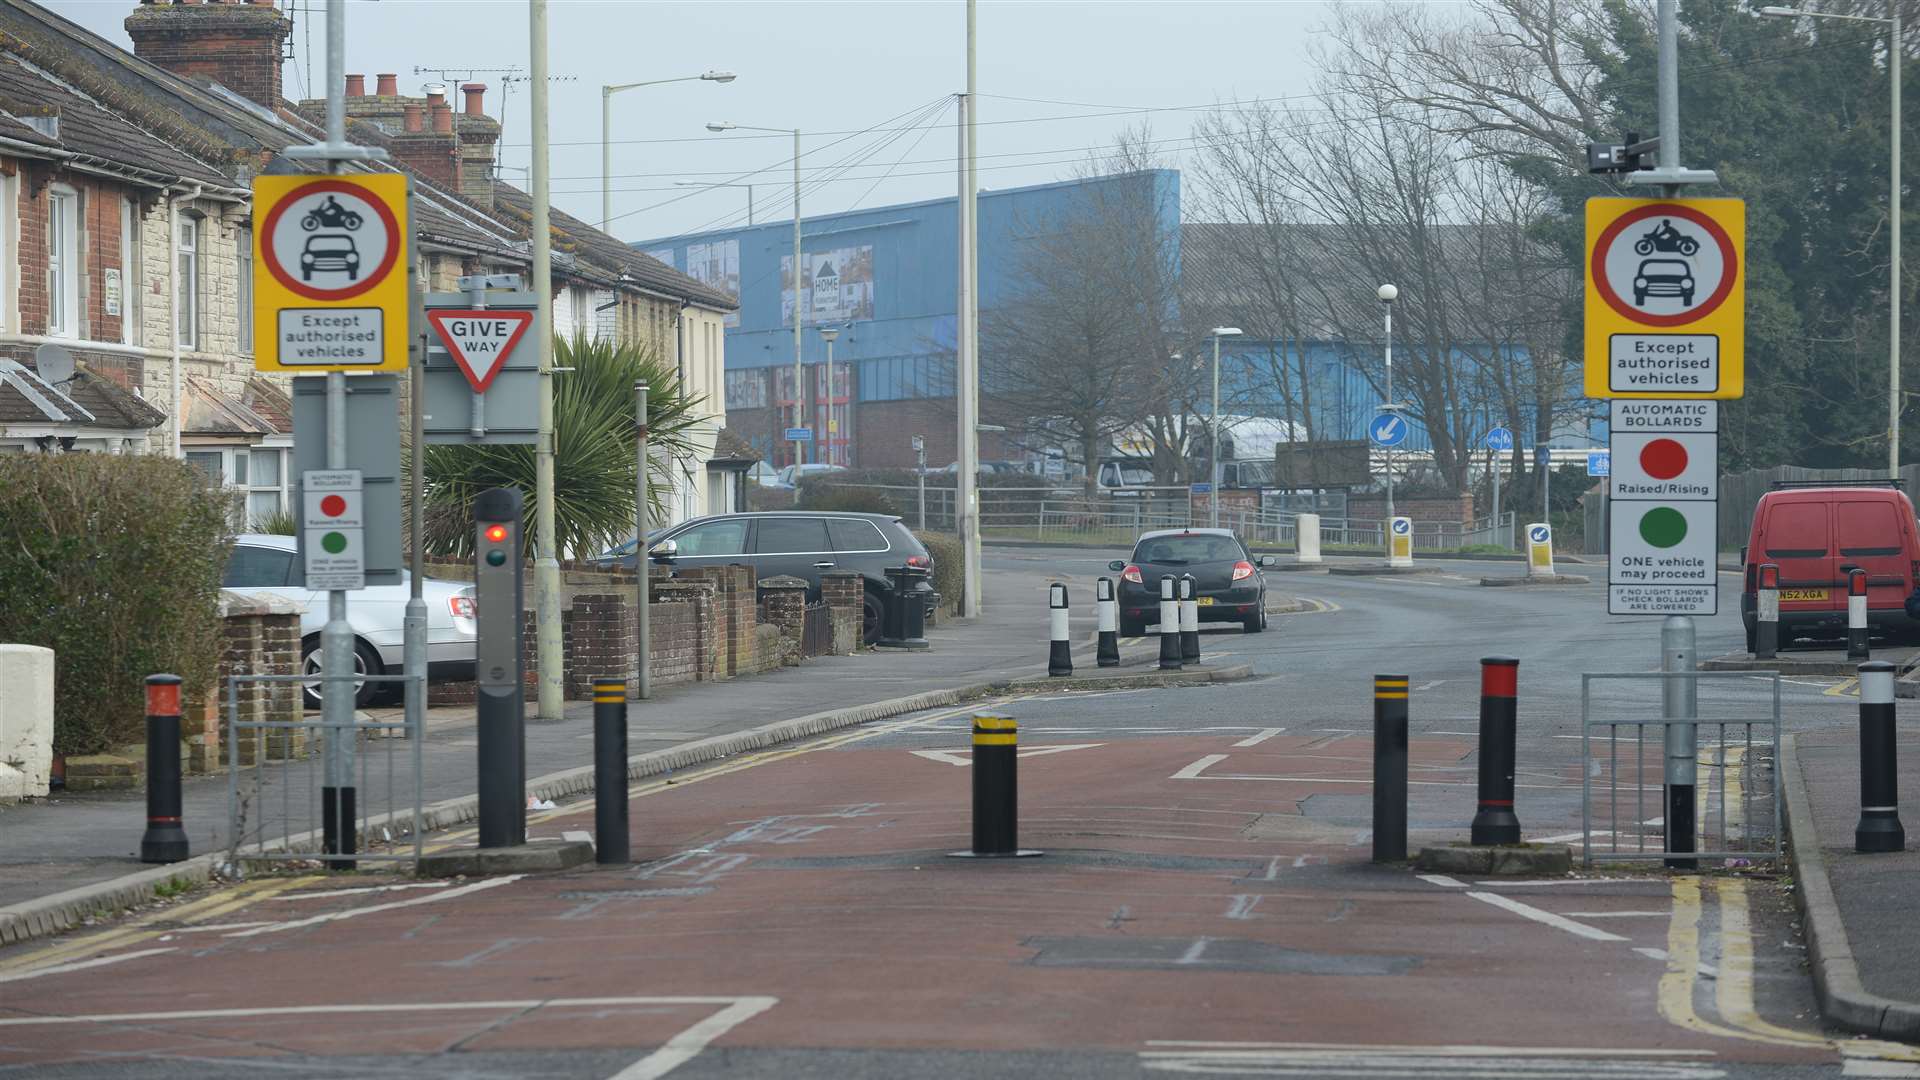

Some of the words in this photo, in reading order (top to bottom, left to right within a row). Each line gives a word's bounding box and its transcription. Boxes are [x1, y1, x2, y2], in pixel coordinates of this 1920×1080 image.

[815, 277, 838, 292] HOME
[302, 315, 360, 328] Except
[451, 321, 507, 337] GIVE
[286, 330, 375, 342] authorised
[297, 346, 364, 358] vehicles
[465, 341, 499, 352] WAY
[1635, 341, 1694, 355] Except
[1617, 357, 1710, 368] authorised
[1629, 372, 1699, 384] vehicles
[1622, 405, 1707, 415] AUTOMATIC
[1625, 417, 1702, 426] BOLLARDS
[1619, 484, 1709, 495] Raised/Rising
[1622, 556, 1653, 567] ONE
[1658, 557, 1704, 567] vehicle
[1621, 570, 1648, 579] may
[1652, 570, 1705, 579] proceed
